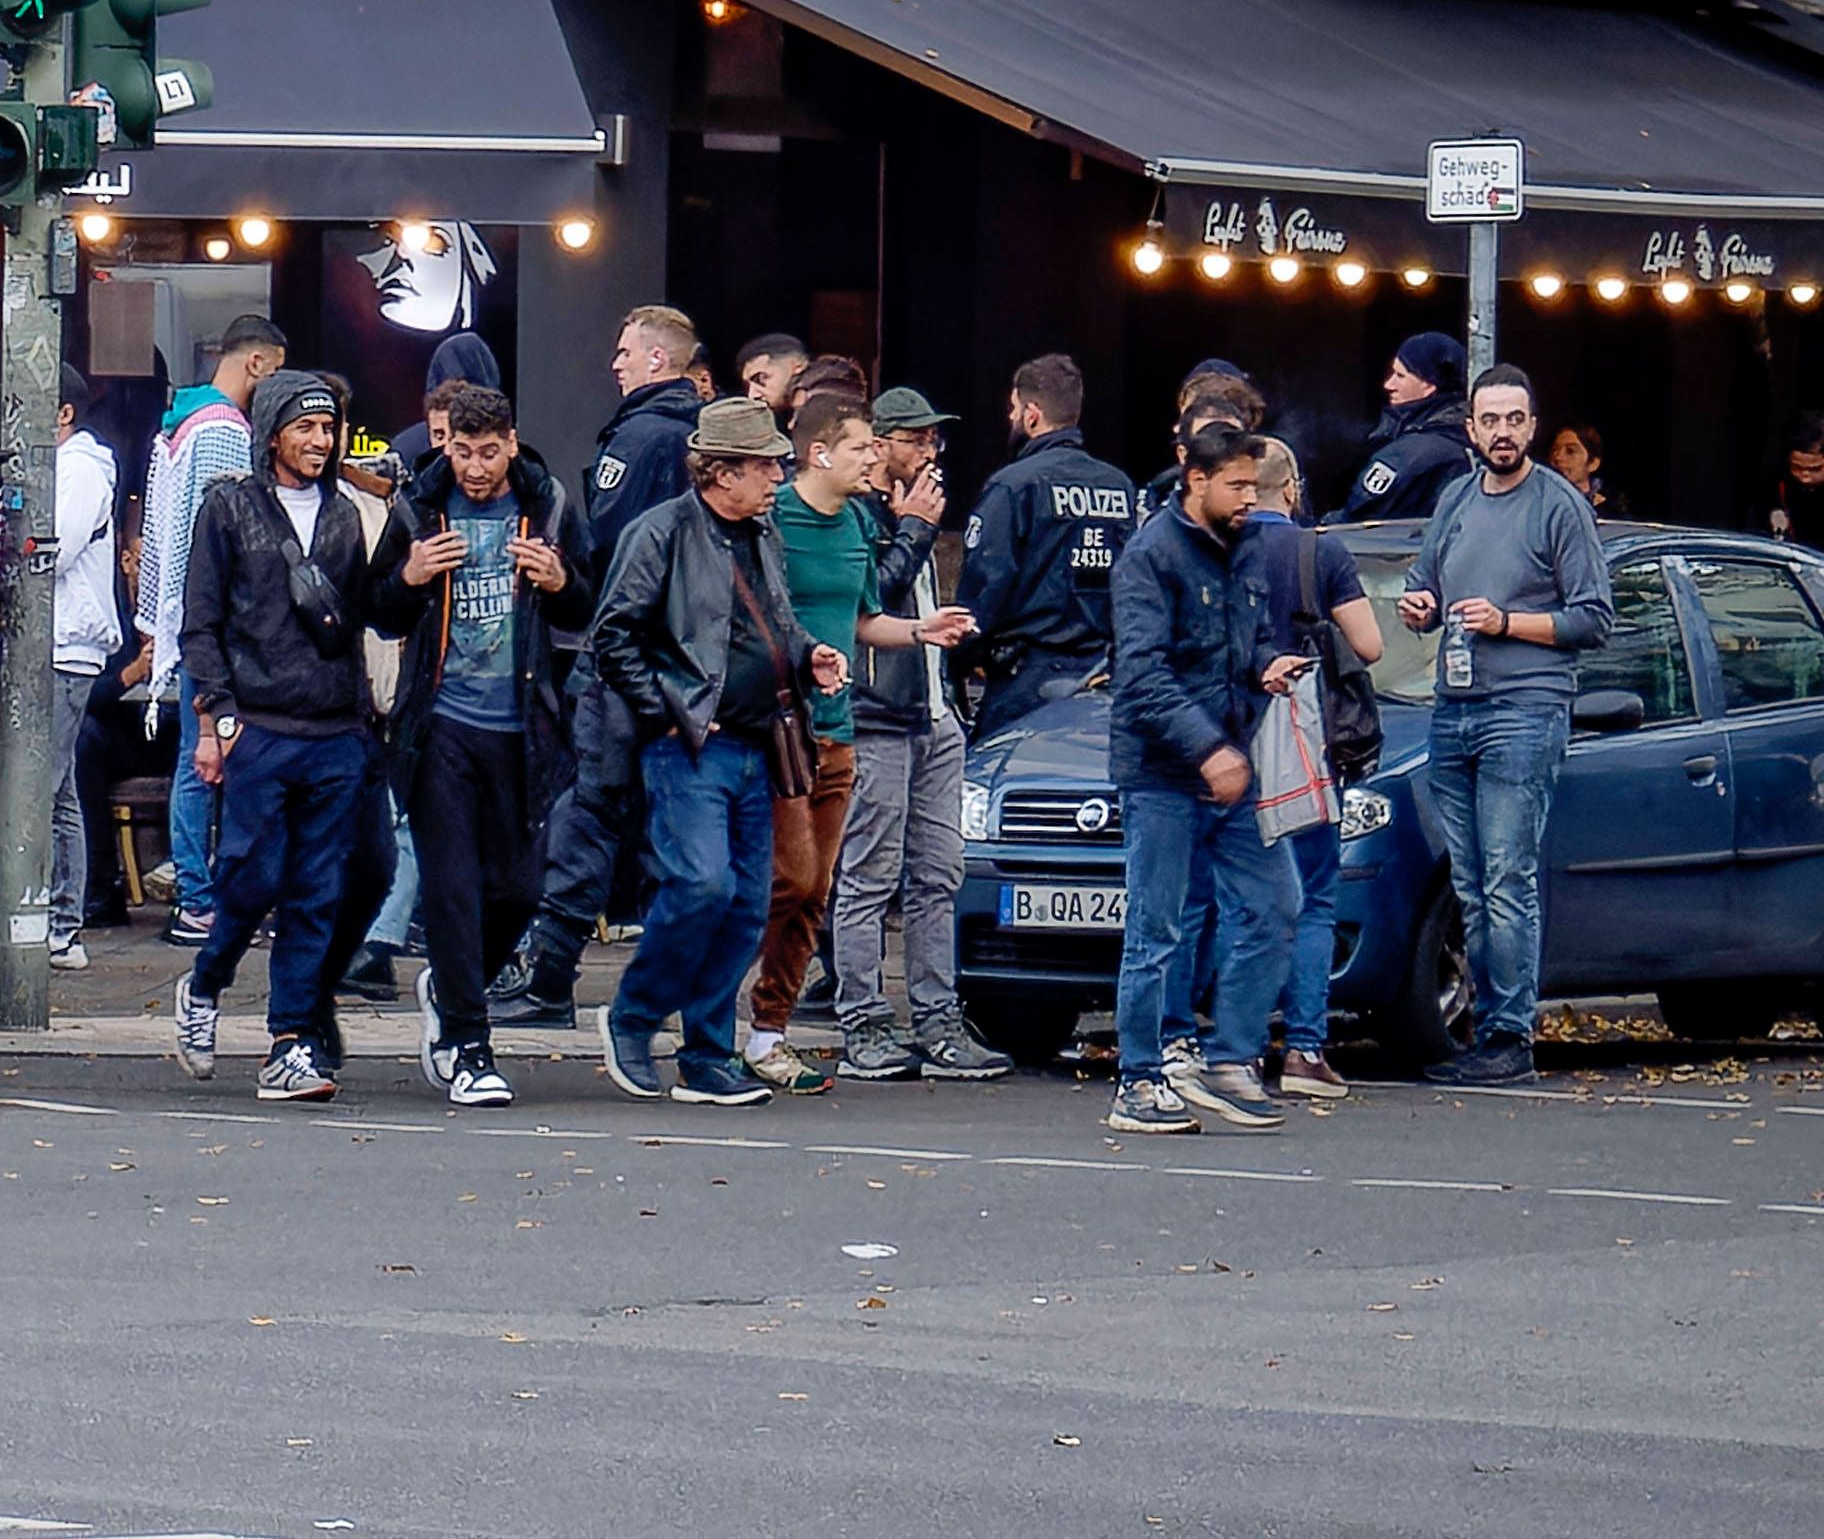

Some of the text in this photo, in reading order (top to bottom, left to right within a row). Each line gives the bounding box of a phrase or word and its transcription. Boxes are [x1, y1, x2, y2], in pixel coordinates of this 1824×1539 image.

[1438, 156, 1509, 181] Gehweg-
[1440, 181, 1490, 208] schäd
[1051, 485, 1131, 519] POLIZEI
[1083, 527, 1105, 547] BE
[1070, 548, 1113, 568] 24319
[1016, 890, 1129, 923] B QA 24
